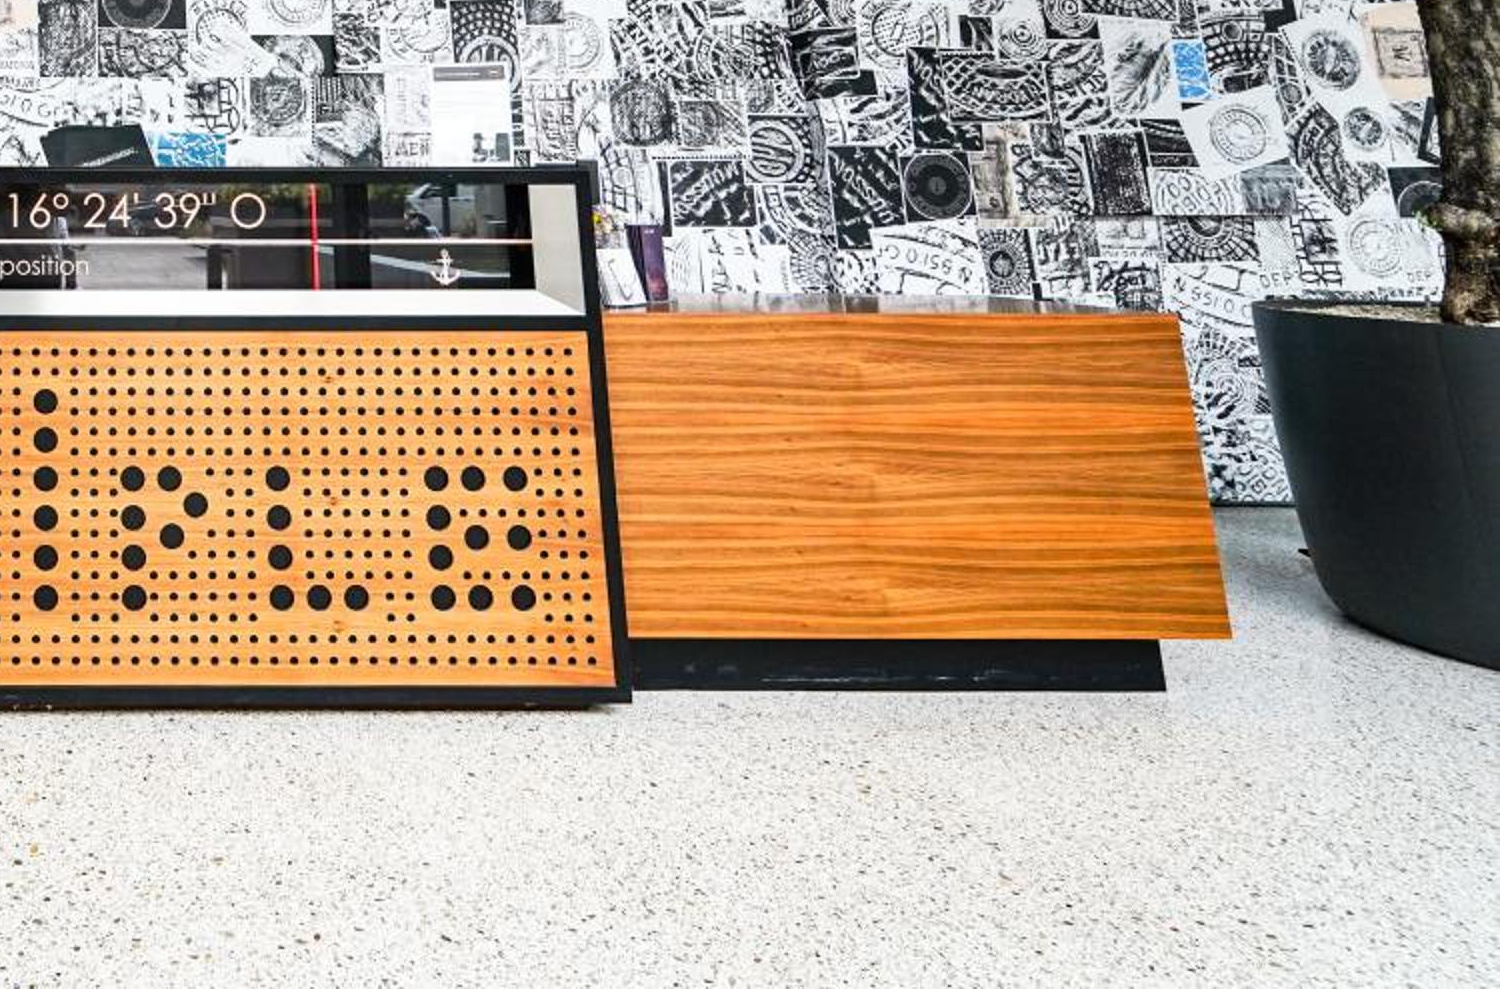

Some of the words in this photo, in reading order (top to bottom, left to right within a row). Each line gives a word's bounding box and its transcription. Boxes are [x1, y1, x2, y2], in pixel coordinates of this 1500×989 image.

[83, 192, 140, 230] 24'
[153, 192, 217, 230] 39"
[230, 192, 267, 230] O
[0, 254, 91, 283] position
